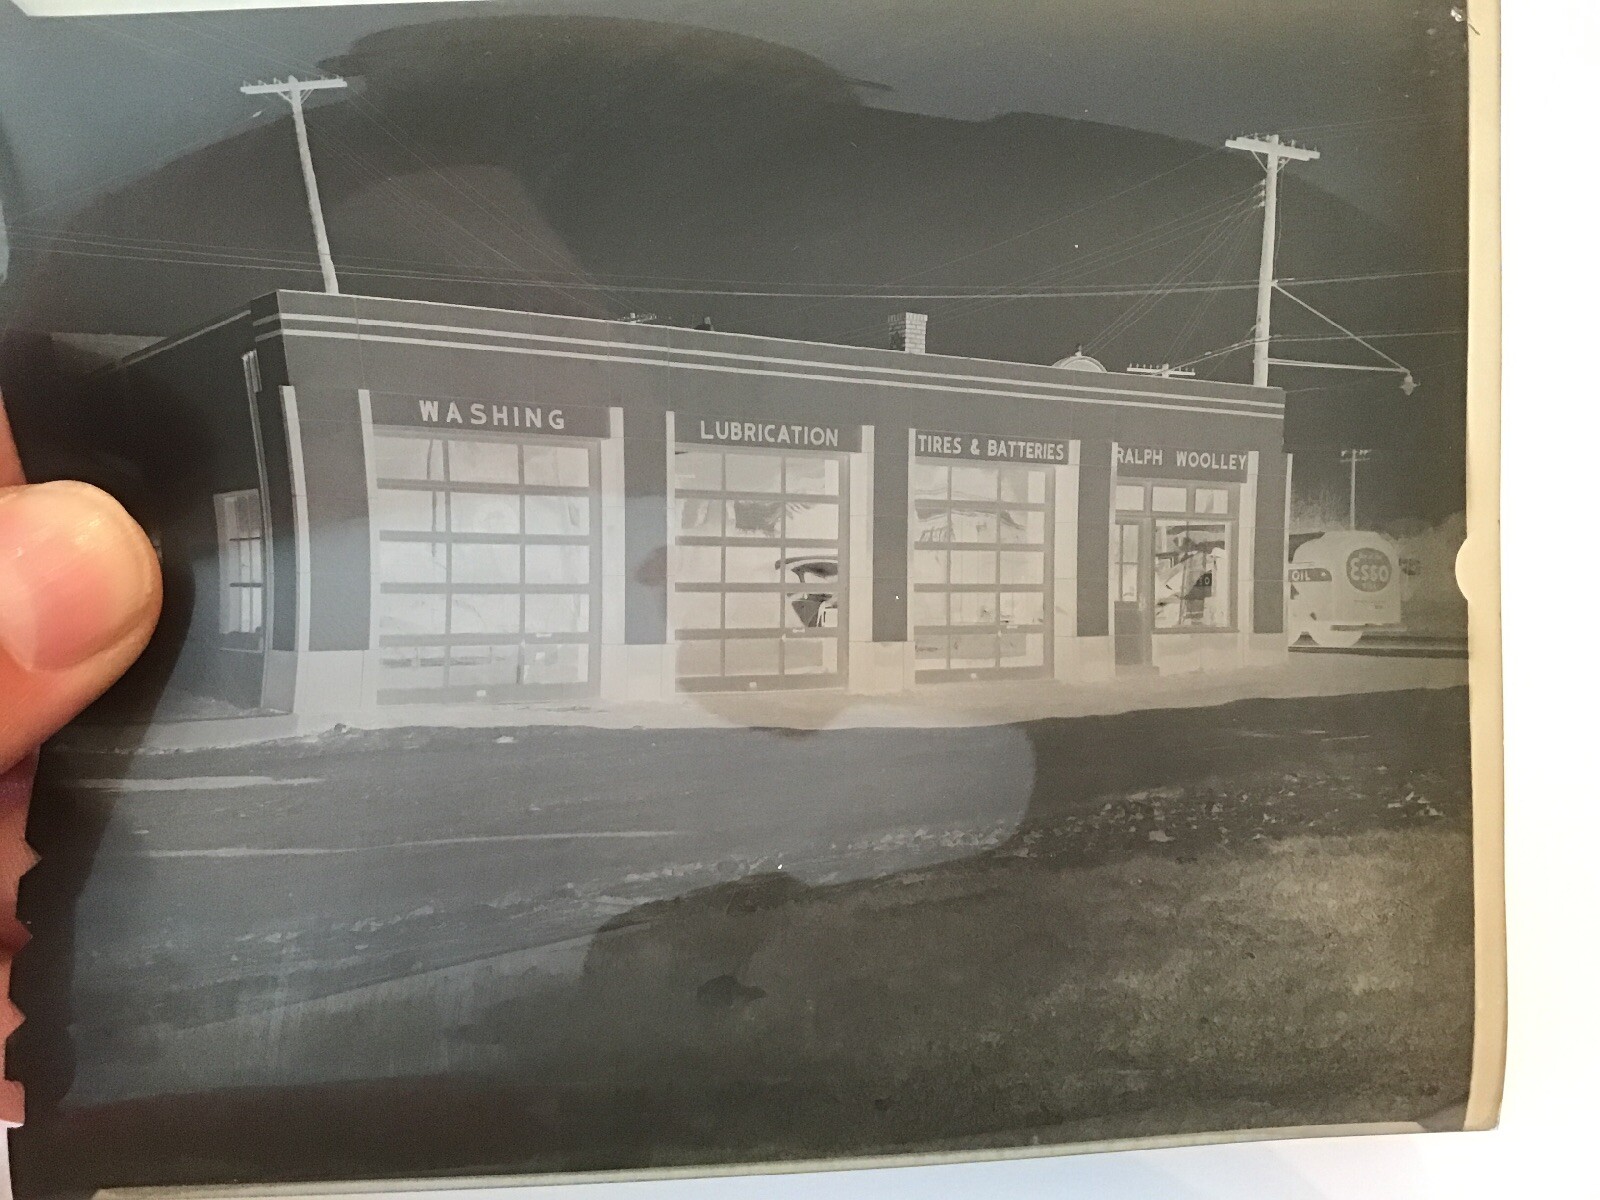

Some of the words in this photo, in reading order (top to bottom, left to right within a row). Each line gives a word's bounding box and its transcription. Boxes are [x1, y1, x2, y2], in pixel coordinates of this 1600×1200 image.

[418, 400, 565, 429] WASHING
[700, 420, 839, 447] LUBRICATION
[917, 434, 962, 454] TIRES
[970, 438, 980, 456] &
[987, 439, 1065, 461] BATTERIES
[1116, 446, 1163, 466] RALPH
[1176, 450, 1247, 470] WOOLLEY
[1291, 570, 1311, 581] OIL
